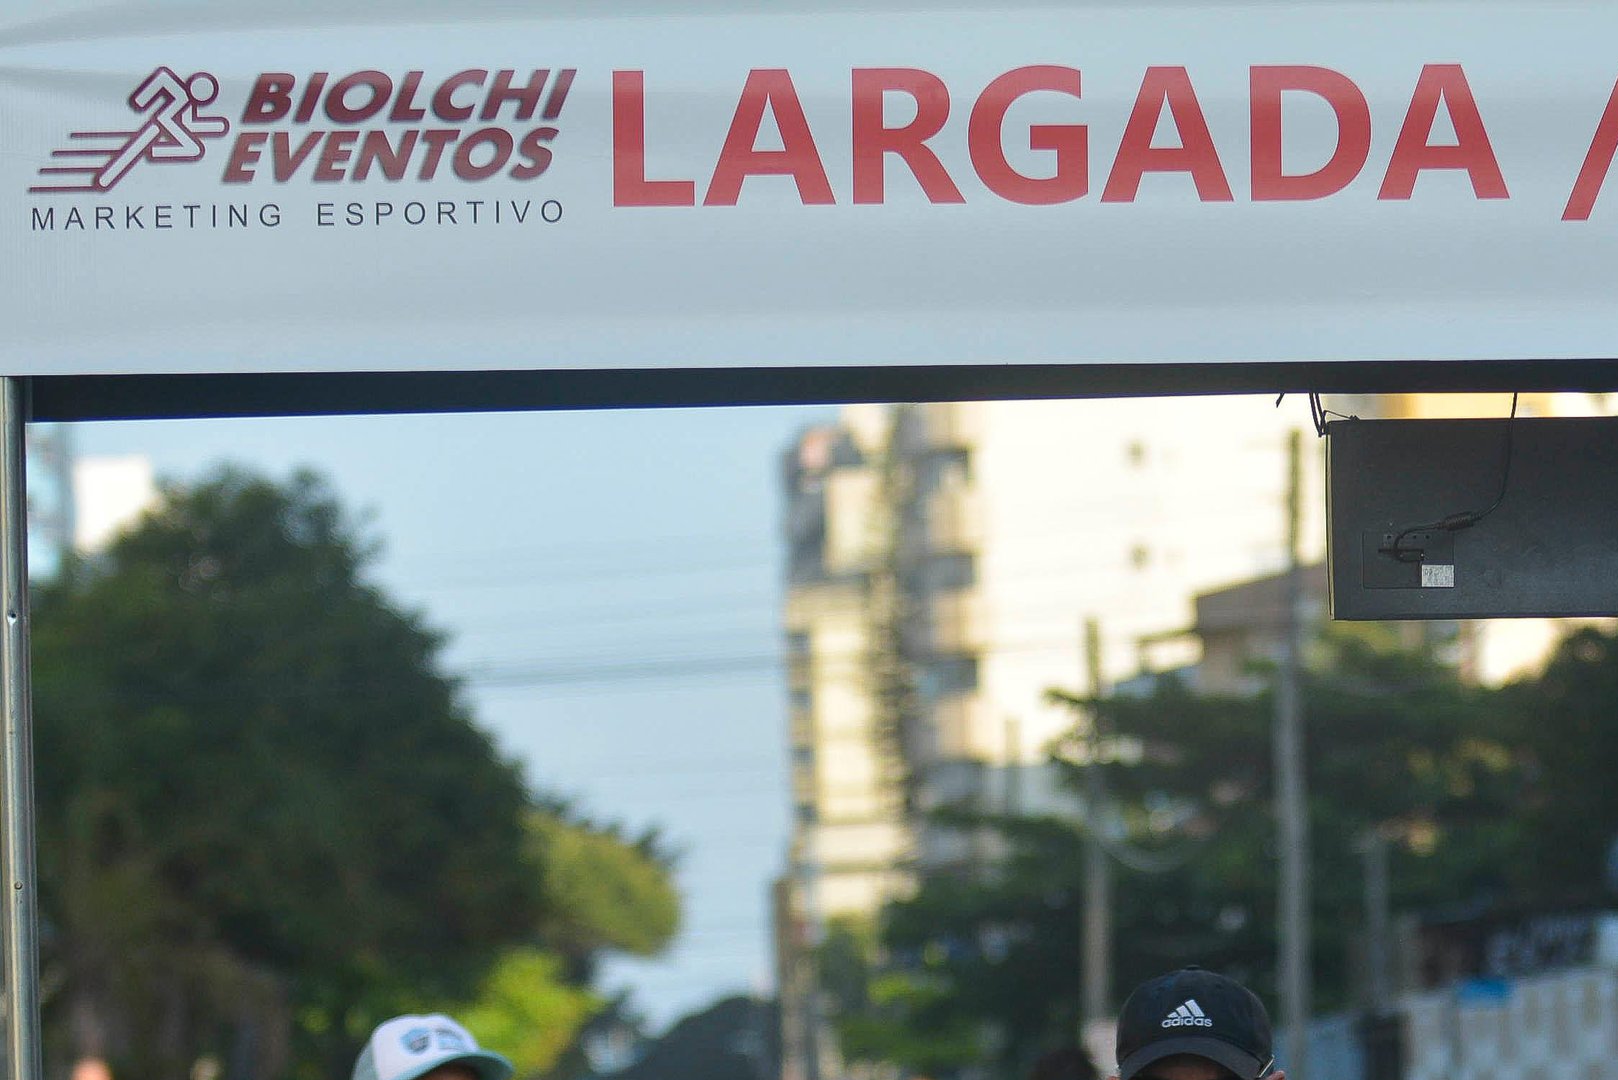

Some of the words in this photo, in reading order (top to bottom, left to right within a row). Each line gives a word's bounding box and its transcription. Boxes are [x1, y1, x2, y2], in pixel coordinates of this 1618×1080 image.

[243, 69, 577, 122] BIOLCHI
[223, 128, 559, 182] EVENTOS
[612, 64, 1511, 207] LARGADA
[31, 203, 282, 231] MARKETING
[317, 200, 564, 226] ESPORTIVO
[1161, 1016, 1213, 1028] adidas
